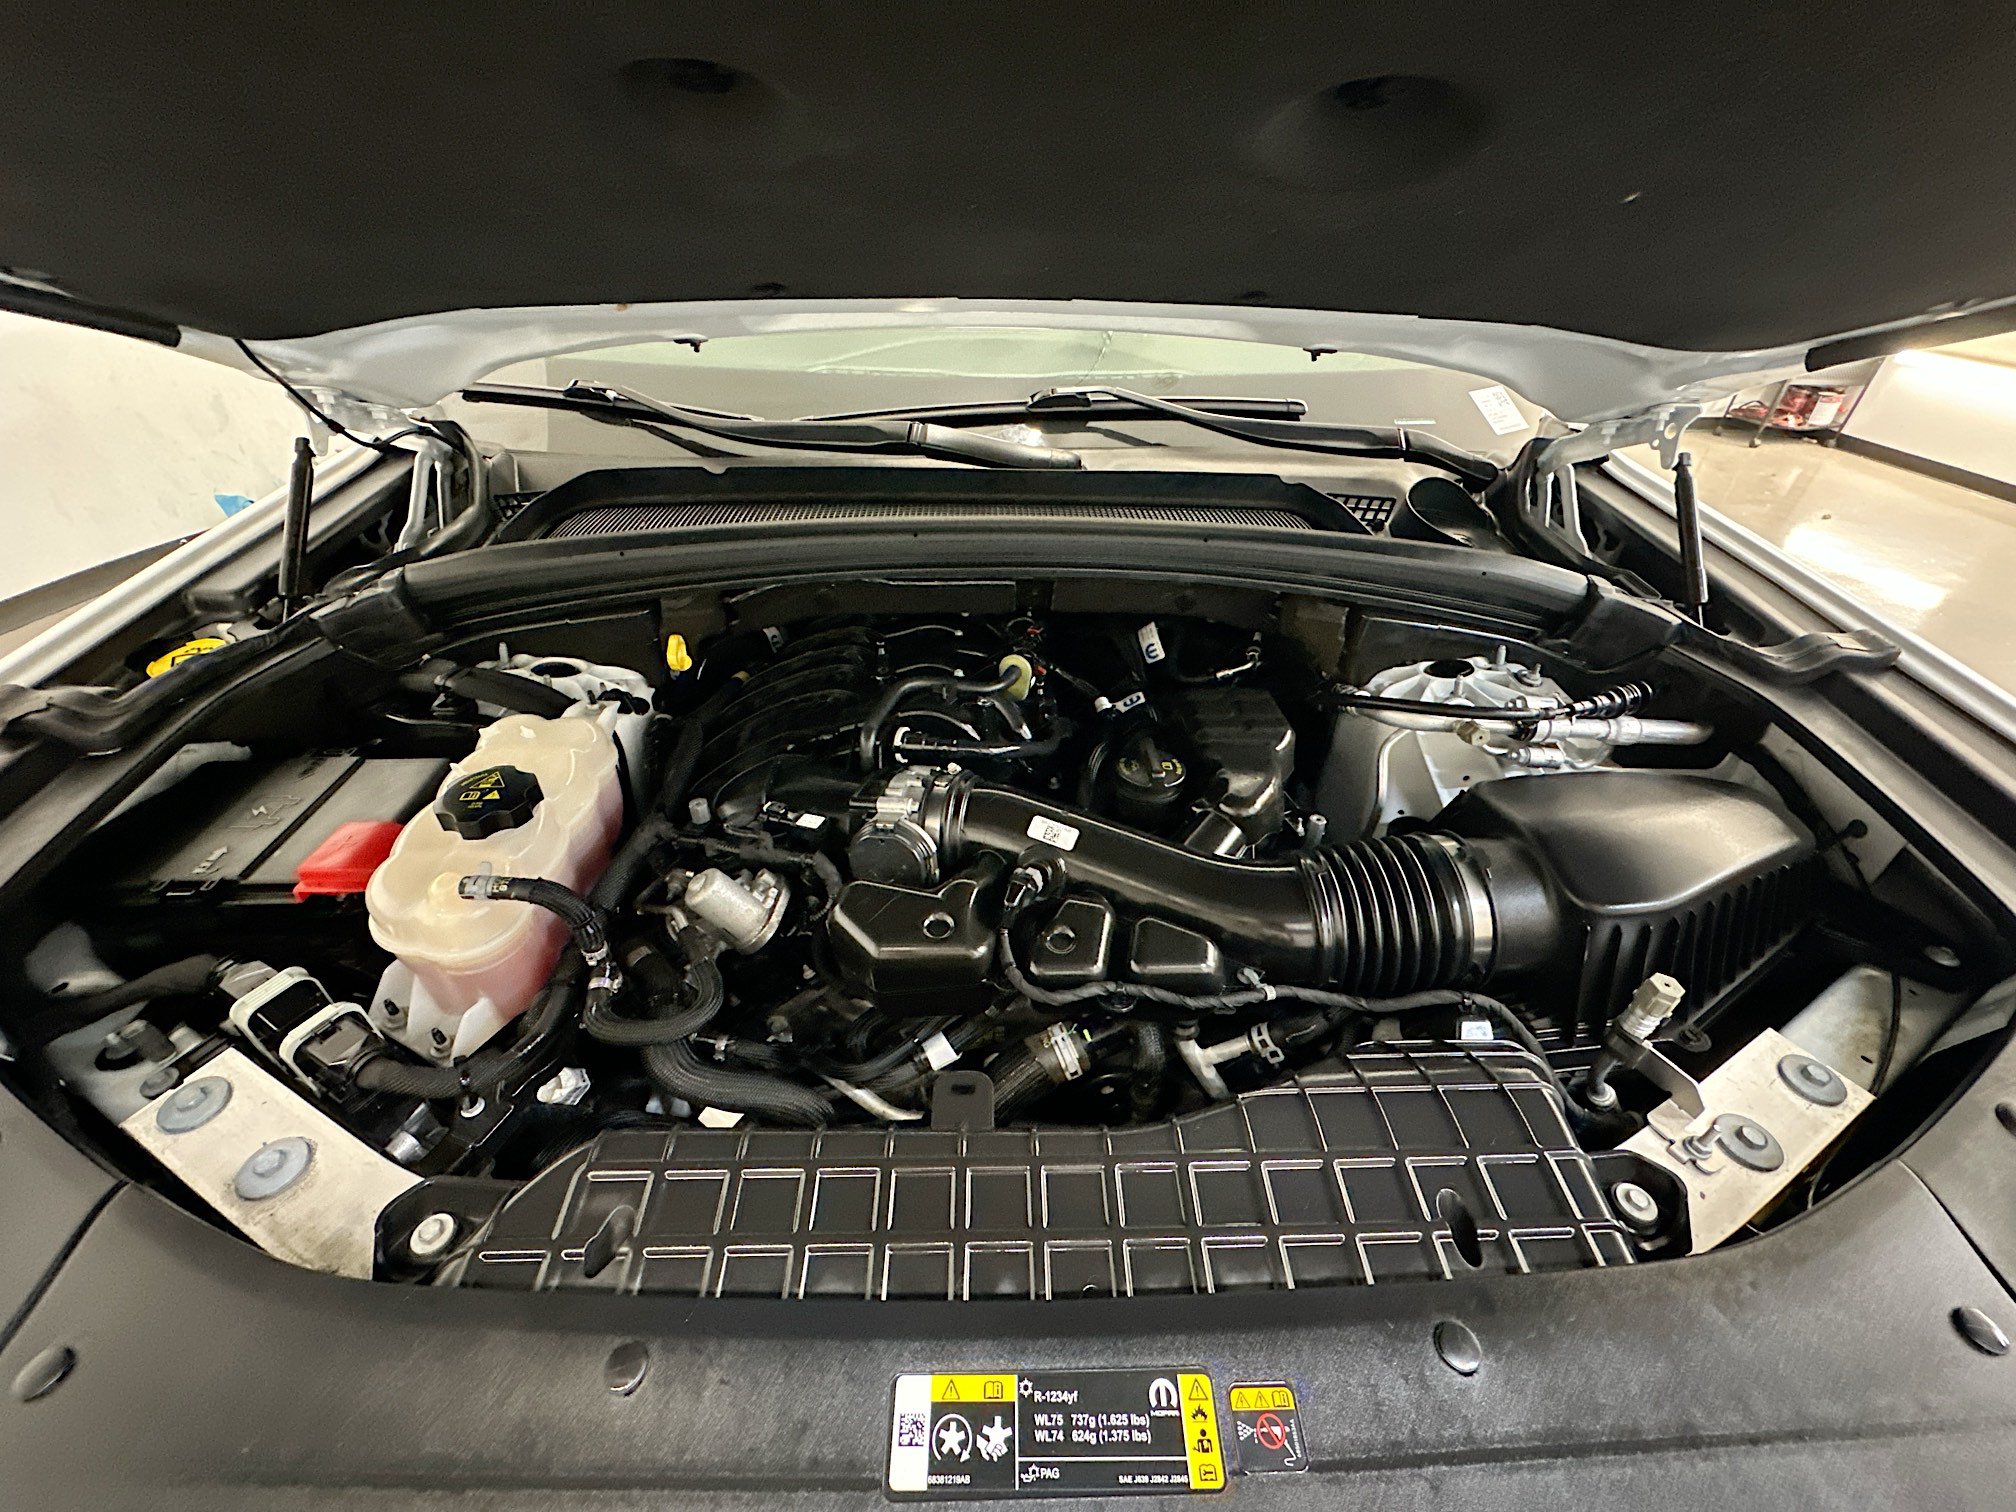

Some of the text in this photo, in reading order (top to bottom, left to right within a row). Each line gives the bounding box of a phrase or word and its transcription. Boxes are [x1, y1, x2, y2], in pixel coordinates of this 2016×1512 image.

[1034, 1391, 1079, 1404] R-1234yf
[1034, 1413, 1150, 1428] WL75 737g (1.625 lbs)
[1034, 1429, 1152, 1444] WL74 624g (1.375 lbs)
[1040, 1467, 1060, 1479] PAG
[1118, 1475, 1133, 1484] SAE
